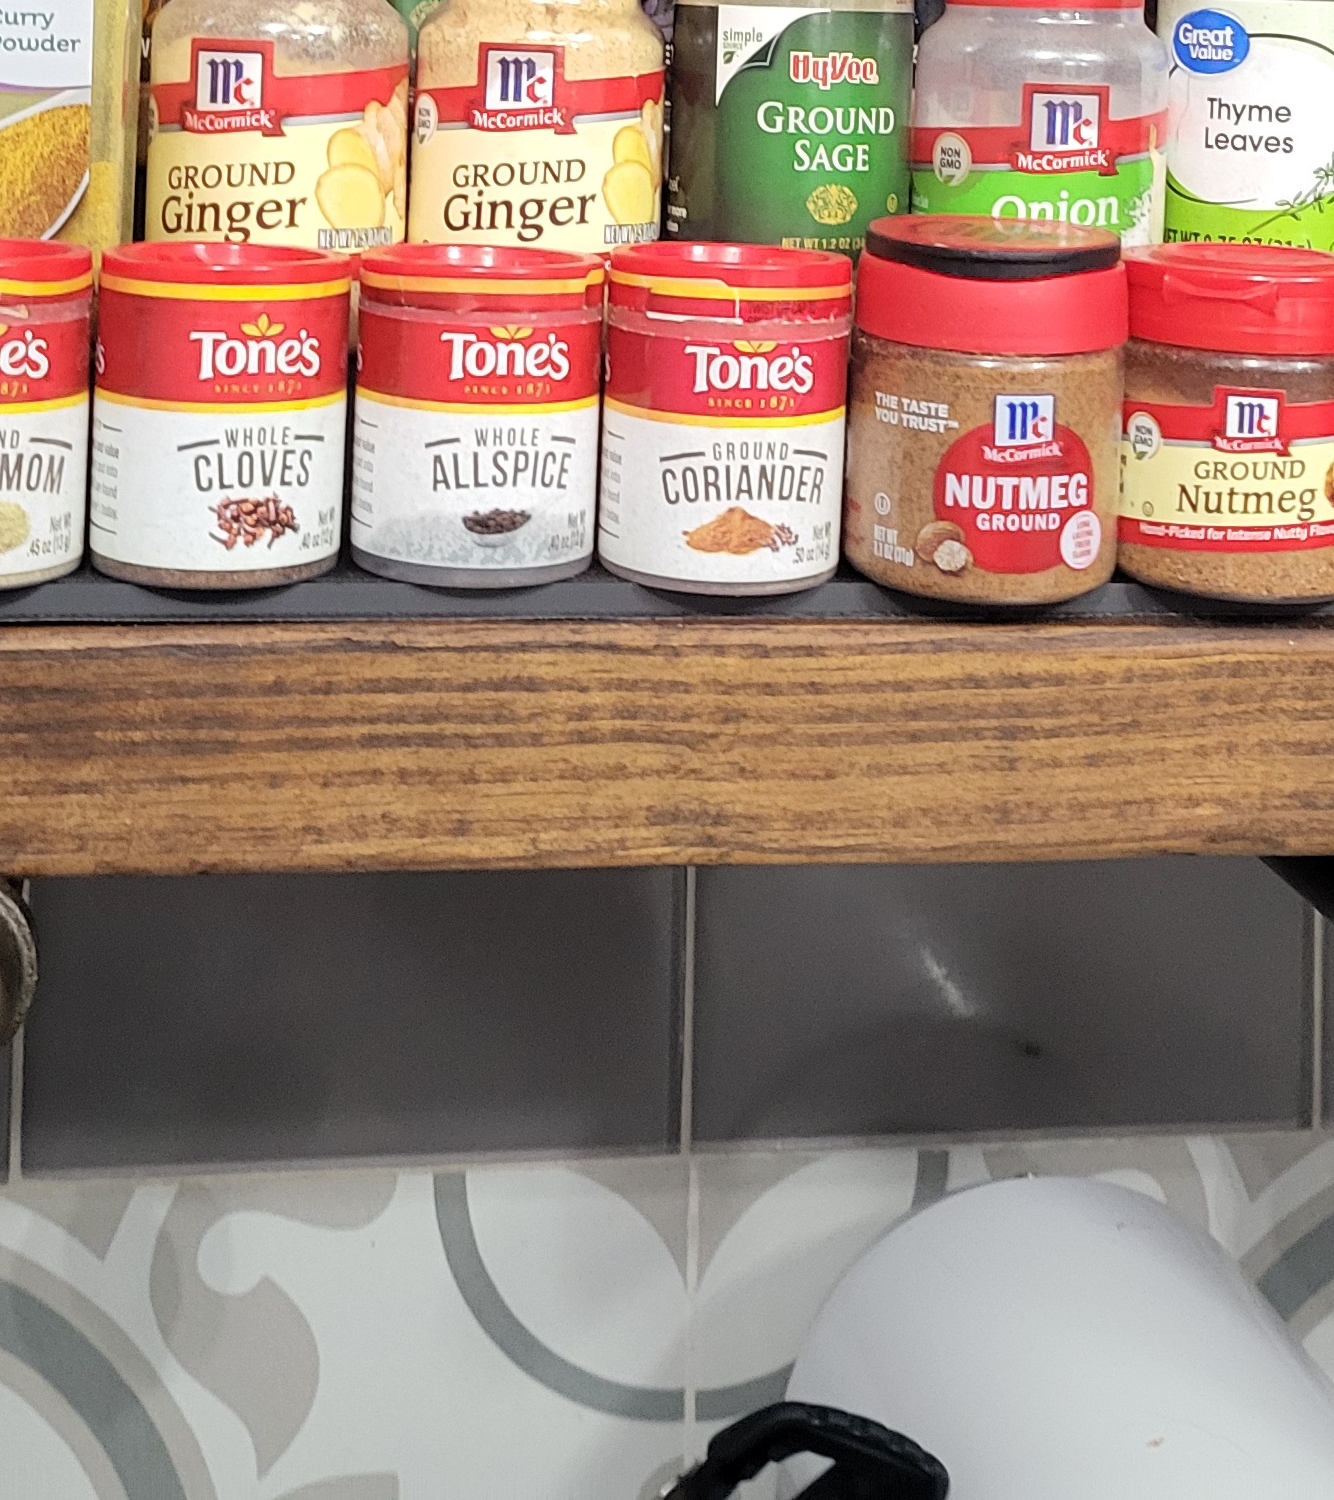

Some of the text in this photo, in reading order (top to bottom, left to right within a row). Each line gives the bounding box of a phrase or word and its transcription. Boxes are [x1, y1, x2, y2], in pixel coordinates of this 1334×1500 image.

[722, 27, 763, 47] simple
[1178, 23, 1234, 47] Great
[1189, 44, 1234, 62] Value
[184, 110, 274, 132] McCormick
[473, 108, 565, 130] McCormick
[756, 101, 895, 134] GROUND
[1207, 97, 1292, 126] Thyme
[940, 147, 961, 159] NON
[1204, 127, 1294, 154] Leaves
[793, 139, 869, 171] SAGE
[939, 158, 962, 170] GMO
[1016, 150, 1108, 171] McCormick
[168, 161, 296, 190] GROUND
[452, 159, 586, 188] GROUND
[161, 192, 308, 244] Ginger
[443, 190, 597, 242] Ginger
[804, 237, 819, 250] WT
[189, 329, 320, 380] Tone's
[440, 331, 569, 380] Tone's
[684, 346, 814, 394] Tone's
[875, 391, 949, 419] THE TASTE
[875, 407, 947, 433] YOU TRUST
[1135, 424, 1153, 436] NON
[225, 427, 291, 448] WHOLE
[475, 428, 540, 447] WHOLE
[1214, 436, 1283, 451] McCormick
[712, 442, 789, 461] GROUND
[981, 444, 1062, 463] McCormick
[193, 450, 313, 492] CLOVES
[432, 451, 572, 491] ALLSPICE
[1194, 460, 1306, 480] GROUND
[661, 464, 824, 505] CORIANDER
[945, 473, 1088, 510] NUTMEG
[1176, 483, 1318, 522] Nutmeg
[975, 513, 1060, 532] GROUND
[1207, 528, 1225, 540] for
[1227, 529, 1271, 541] Intense
[1274, 527, 1307, 540] Nutty
